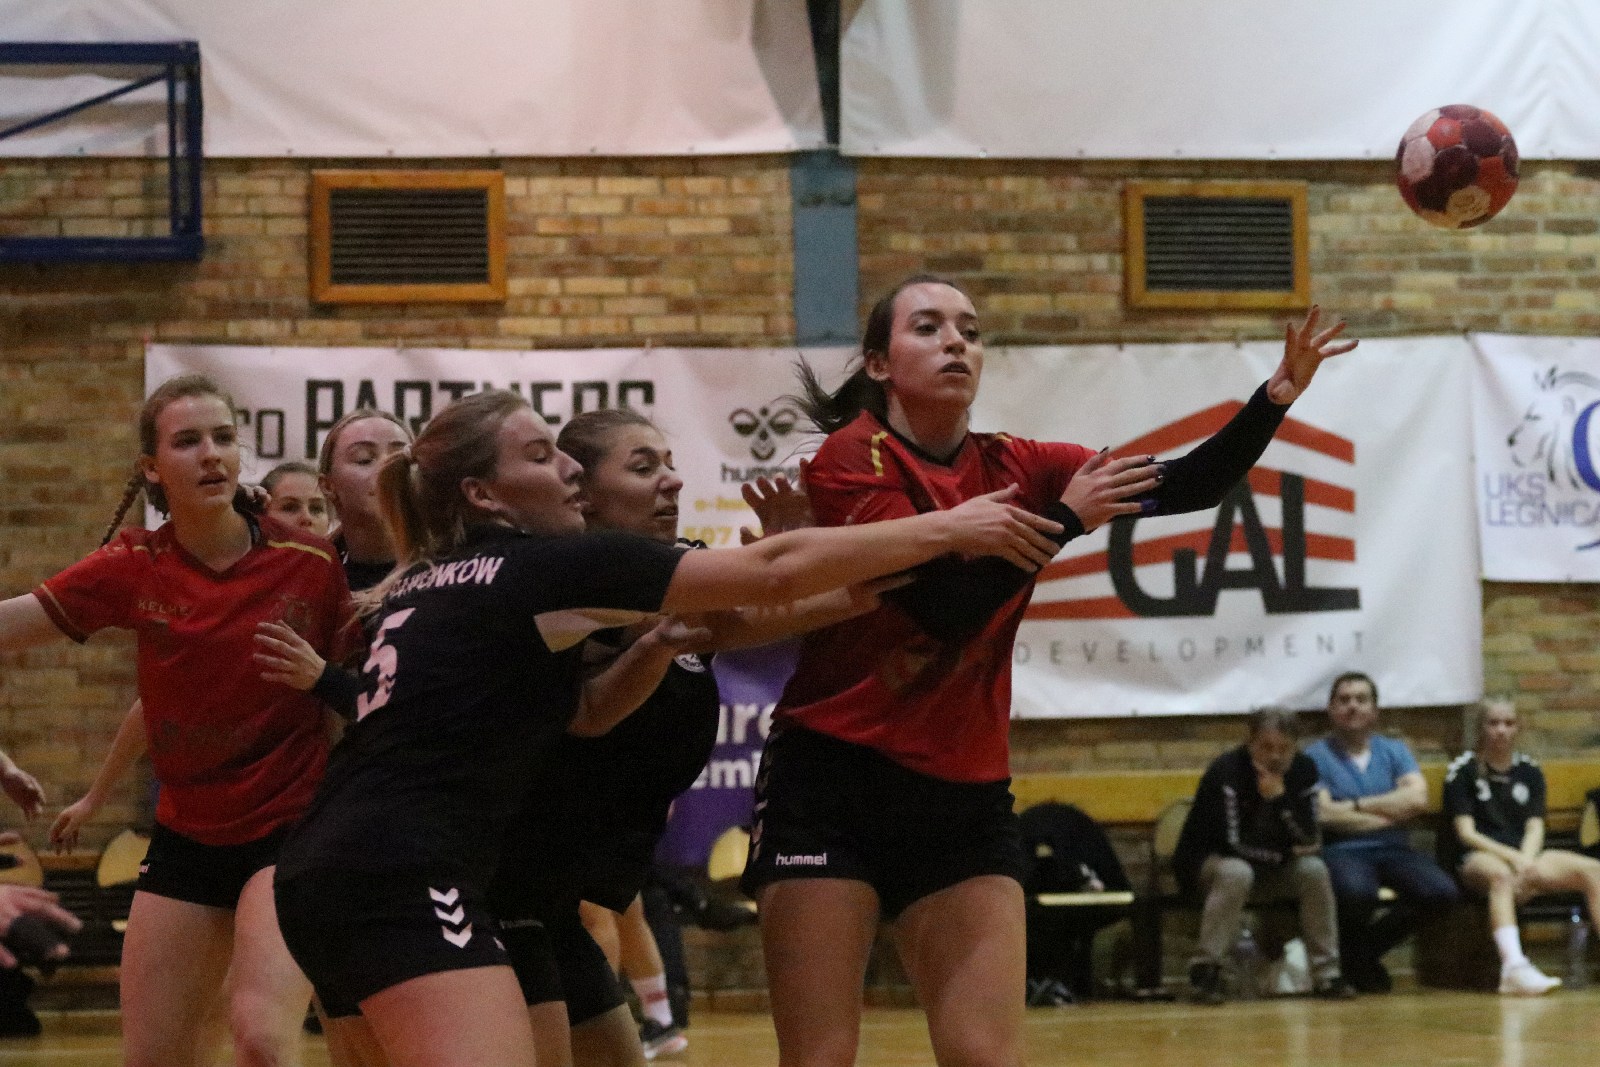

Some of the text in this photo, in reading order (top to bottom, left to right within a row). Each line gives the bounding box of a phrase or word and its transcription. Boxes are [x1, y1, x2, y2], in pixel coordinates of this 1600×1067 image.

[304, 379, 654, 460] PRTE
[1484, 471, 1547, 499] UKS
[1107, 472, 1360, 618] GAL
[1013, 632, 1365, 666] DEVELOPMENT
[776, 852, 827, 866] hummel
